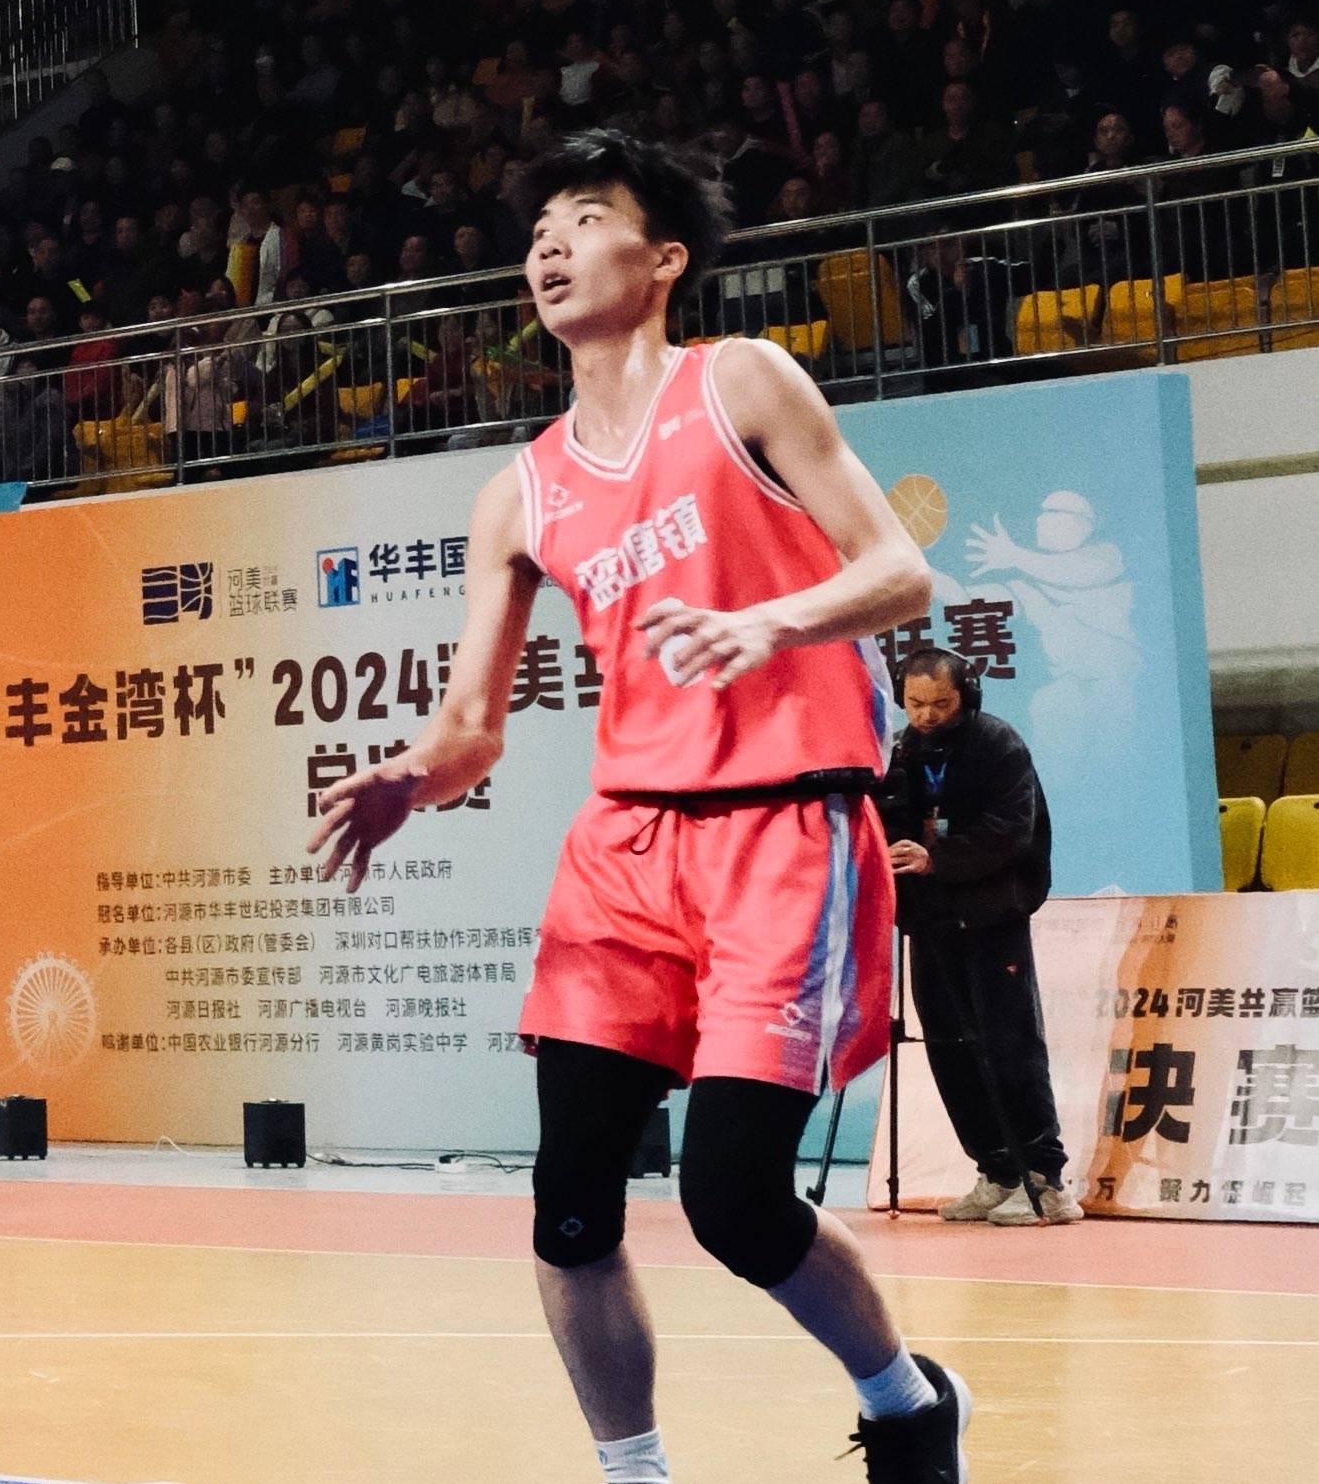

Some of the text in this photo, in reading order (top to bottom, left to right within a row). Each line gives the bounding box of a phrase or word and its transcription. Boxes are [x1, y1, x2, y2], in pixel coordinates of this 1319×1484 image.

[166, 962, 516, 987] 中共河源市委宣传部 河源市文化广电旅游体育局
[166, 997, 467, 1020] 河源日报社 河源广播电视台 河源晚报社
